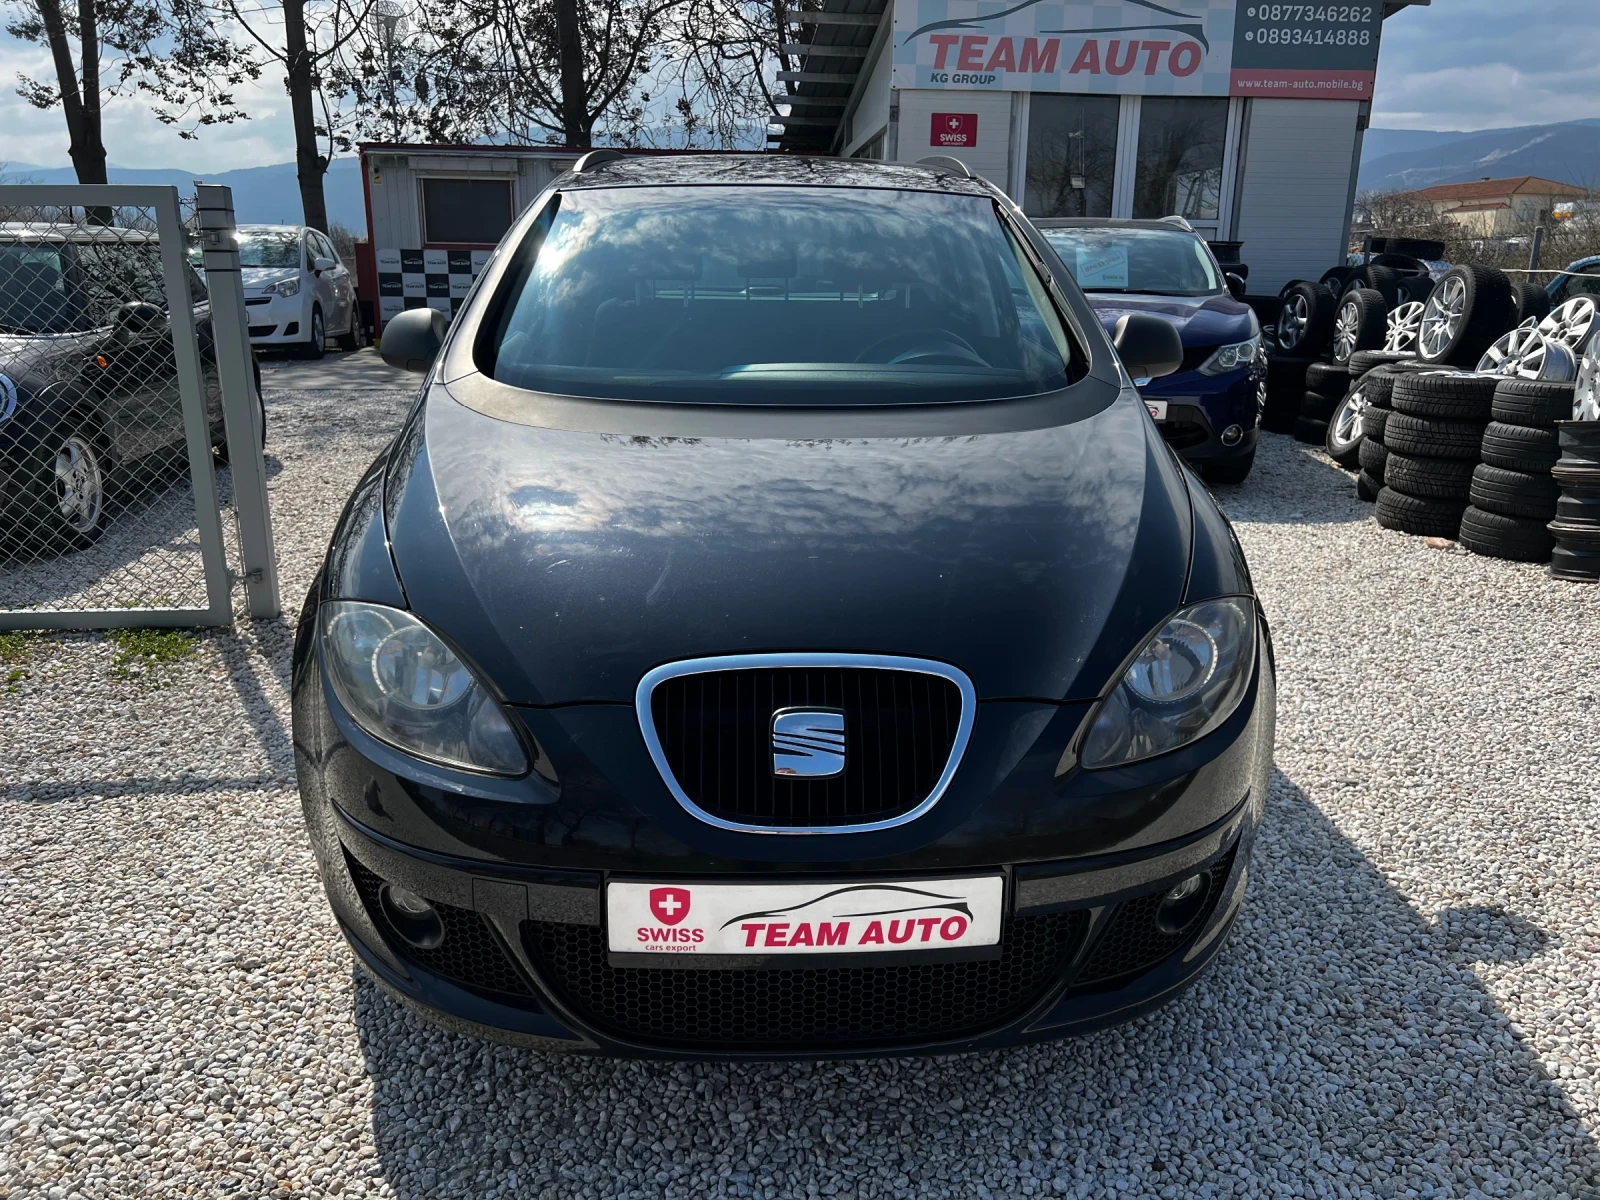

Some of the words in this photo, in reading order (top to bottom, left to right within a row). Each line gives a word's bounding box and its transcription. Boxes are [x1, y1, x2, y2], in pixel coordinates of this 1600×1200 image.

[1258, 4, 1372, 23] 0877346262
[1256, 28, 1370, 46] 0893414888
[929, 34, 1061, 74] TEAM
[1068, 40, 1202, 78] AUTO
[930, 72, 949, 84] KG
[951, 73, 996, 85] GROUP
[1237, 78, 1363, 91] www.team-auto.mobile.bg
[940, 133, 967, 142] SWISS
[637, 927, 704, 943] SWISS
[740, 921, 850, 948] TEAM
[857, 915, 968, 945] AUTO
[665, 944, 697, 953] export
